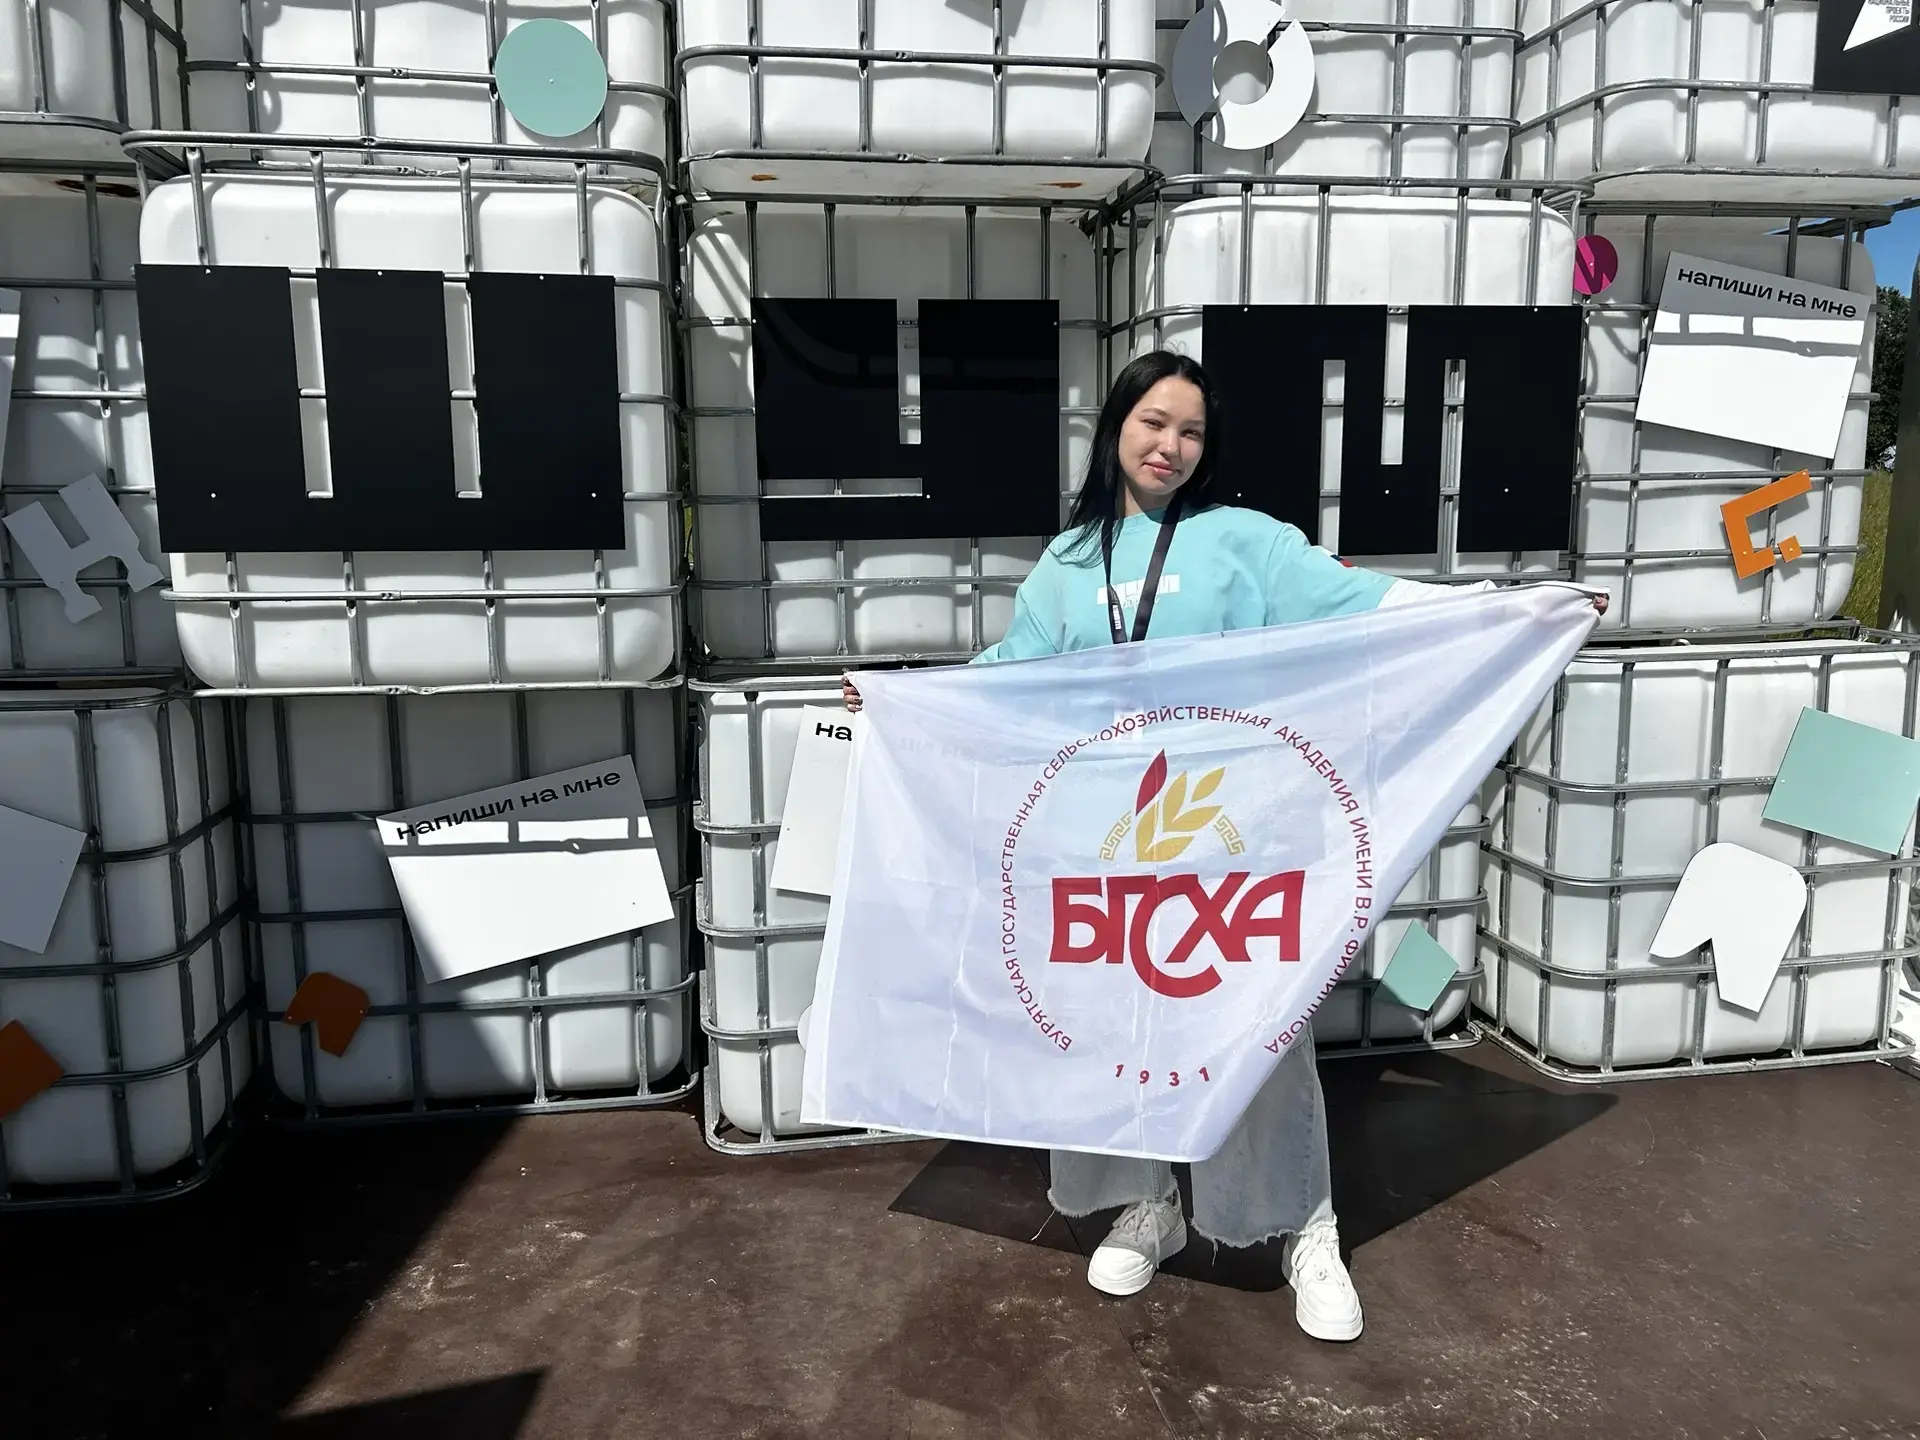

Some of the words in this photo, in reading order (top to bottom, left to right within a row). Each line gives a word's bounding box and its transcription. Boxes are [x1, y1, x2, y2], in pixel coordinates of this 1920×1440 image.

[1677, 268, 1773, 300] напиши
[1777, 289, 1807, 308] на
[1810, 297, 1857, 318] мне
[396, 798, 515, 840] напиши
[520, 788, 559, 808] на
[563, 772, 621, 798] мне
[1273, 725, 1359, 814] АКАДЕМИЯ
[1001, 779, 1047, 954] ГОСУДАРСТВЕННАЯ
[1349, 816, 1373, 889] ИМЕНИ
[1049, 869, 1306, 998] БГСХА
[1005, 957, 1073, 1052] БУРЯТСКАЯ
